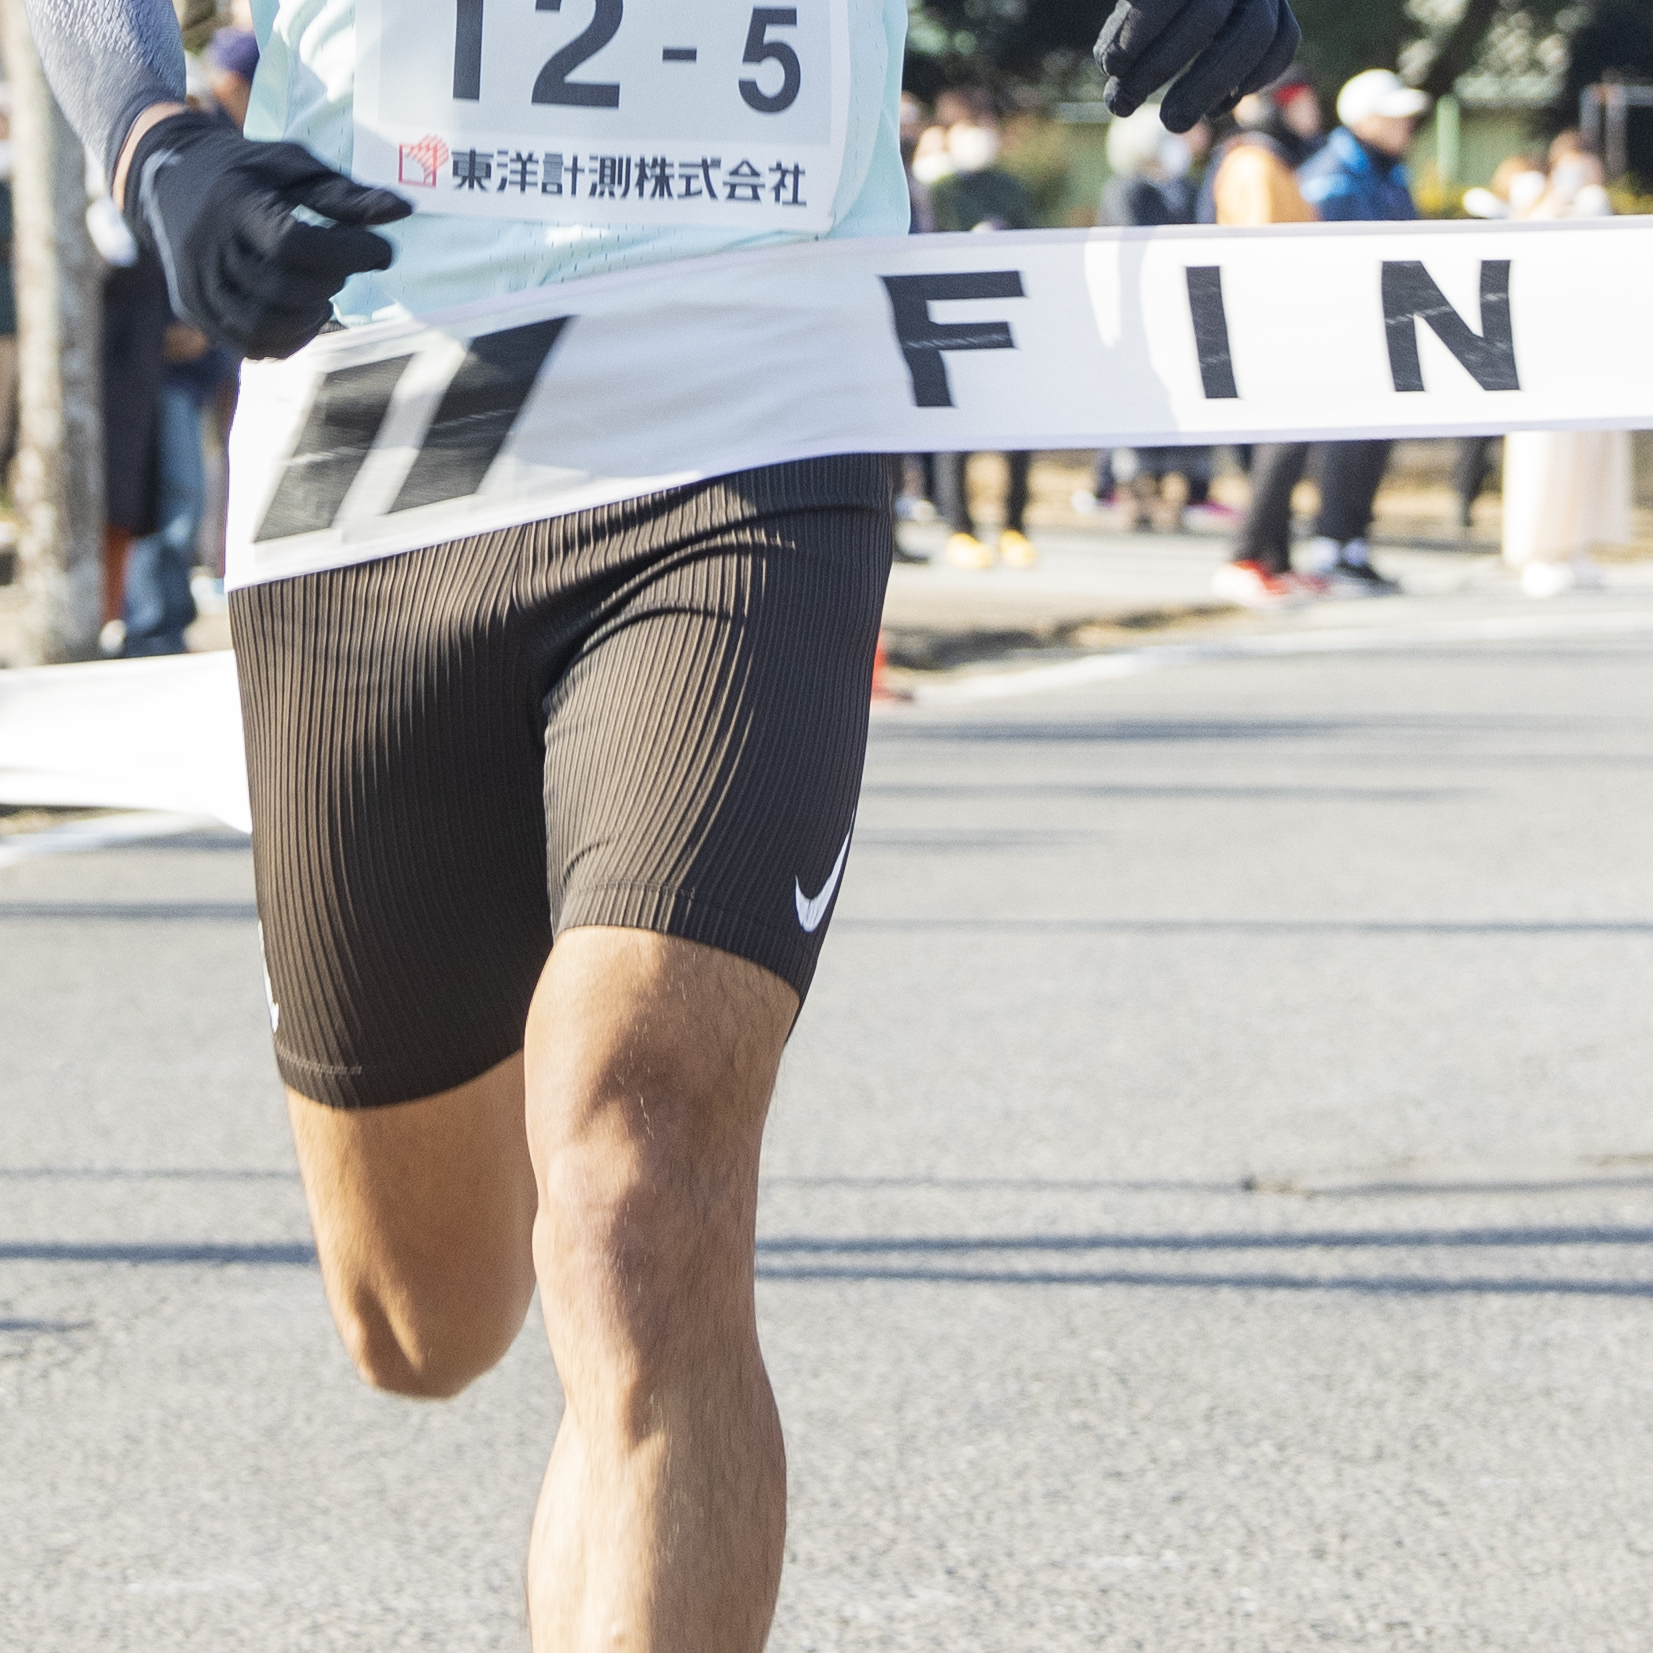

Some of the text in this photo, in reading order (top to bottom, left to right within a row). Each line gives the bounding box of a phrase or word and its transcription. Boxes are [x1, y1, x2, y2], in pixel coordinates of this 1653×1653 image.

[450, 148, 808, 207] 東洋計測株式会社
